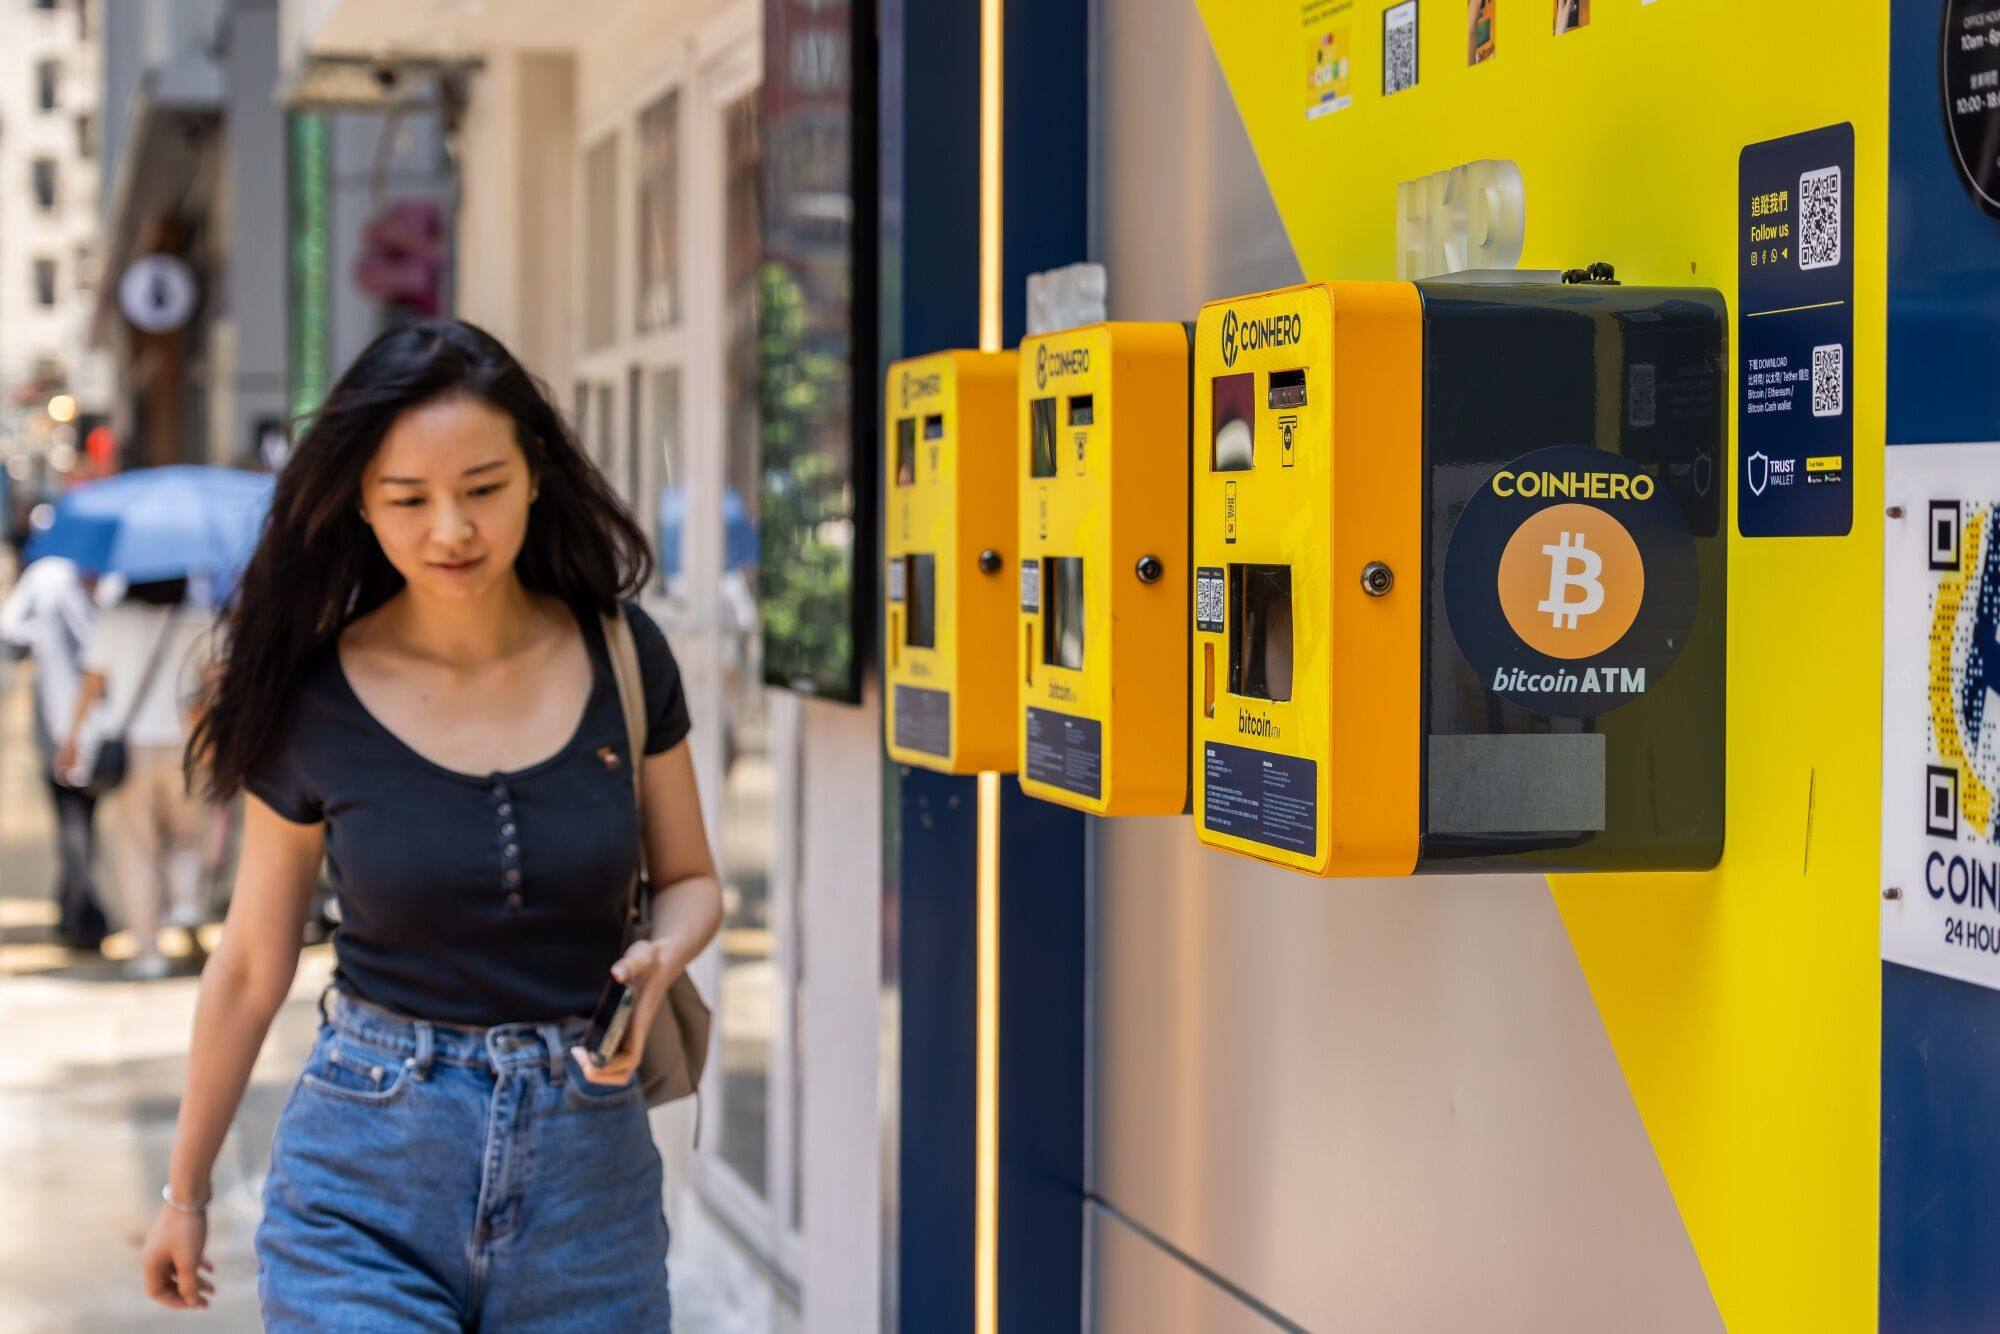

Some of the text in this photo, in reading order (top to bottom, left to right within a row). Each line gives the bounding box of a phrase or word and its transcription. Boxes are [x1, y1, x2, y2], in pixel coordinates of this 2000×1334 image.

[1752, 191, 1787, 217] 追蹤我們
[1751, 224, 1789, 242] Follow us
[1241, 313, 1301, 351] COINHERO
[1759, 357, 1787, 369] DOWNLOAD
[1783, 371, 1798, 382] Tether
[1748, 389, 1764, 399] Bitcoin
[1768, 387, 1790, 398] Ethereum
[1748, 400, 1791, 413] Bitcoin Cash wallet
[1770, 460, 1795, 473] TRUST
[1492, 471, 1655, 501] COINHERO
[1770, 474, 1794, 485] WALLET
[1239, 708, 1271, 738] bitcoin
[1926, 850, 2000, 913] COIN
[1945, 917, 1963, 946] 24
